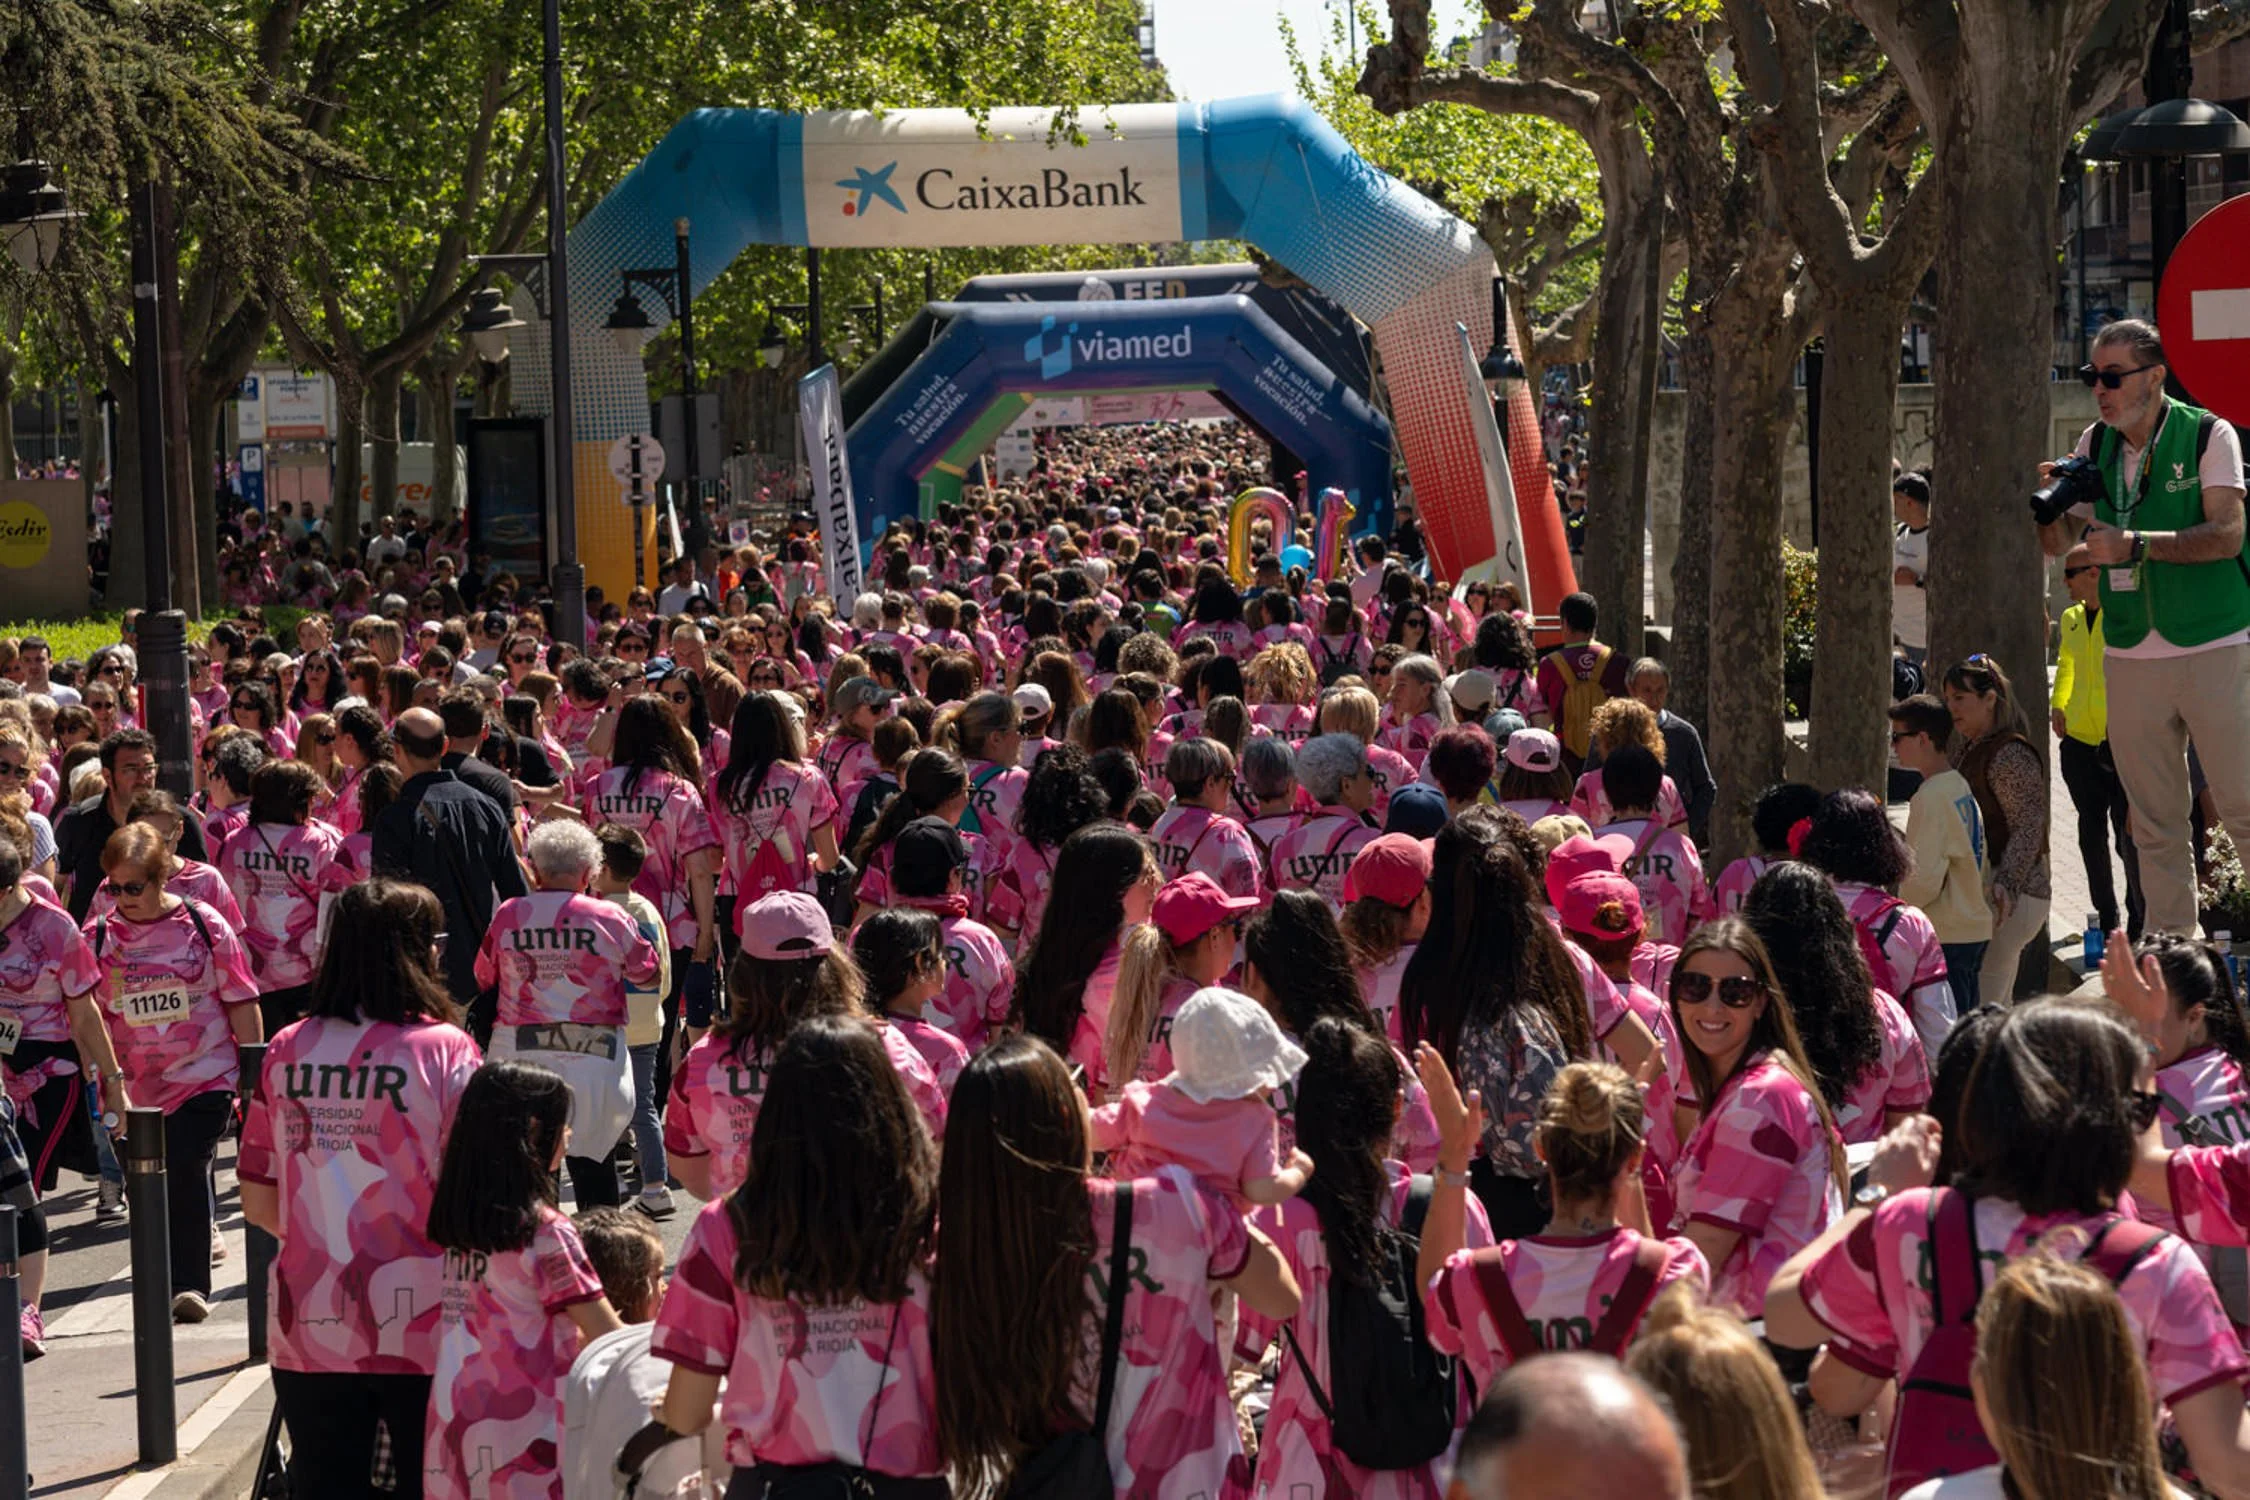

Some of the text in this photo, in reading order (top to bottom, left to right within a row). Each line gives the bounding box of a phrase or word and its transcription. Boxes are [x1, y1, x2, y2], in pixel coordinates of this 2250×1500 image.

[915, 165, 1147, 210] CaixaBank
[1078, 325, 1192, 360] viamed
[1272, 353, 1289, 374] Tu
[894, 408, 916, 426] Tu
[907, 383, 957, 435] nuestra
[130, 991, 181, 1015] 11126
[317, 1138, 353, 1151] RIOJA
